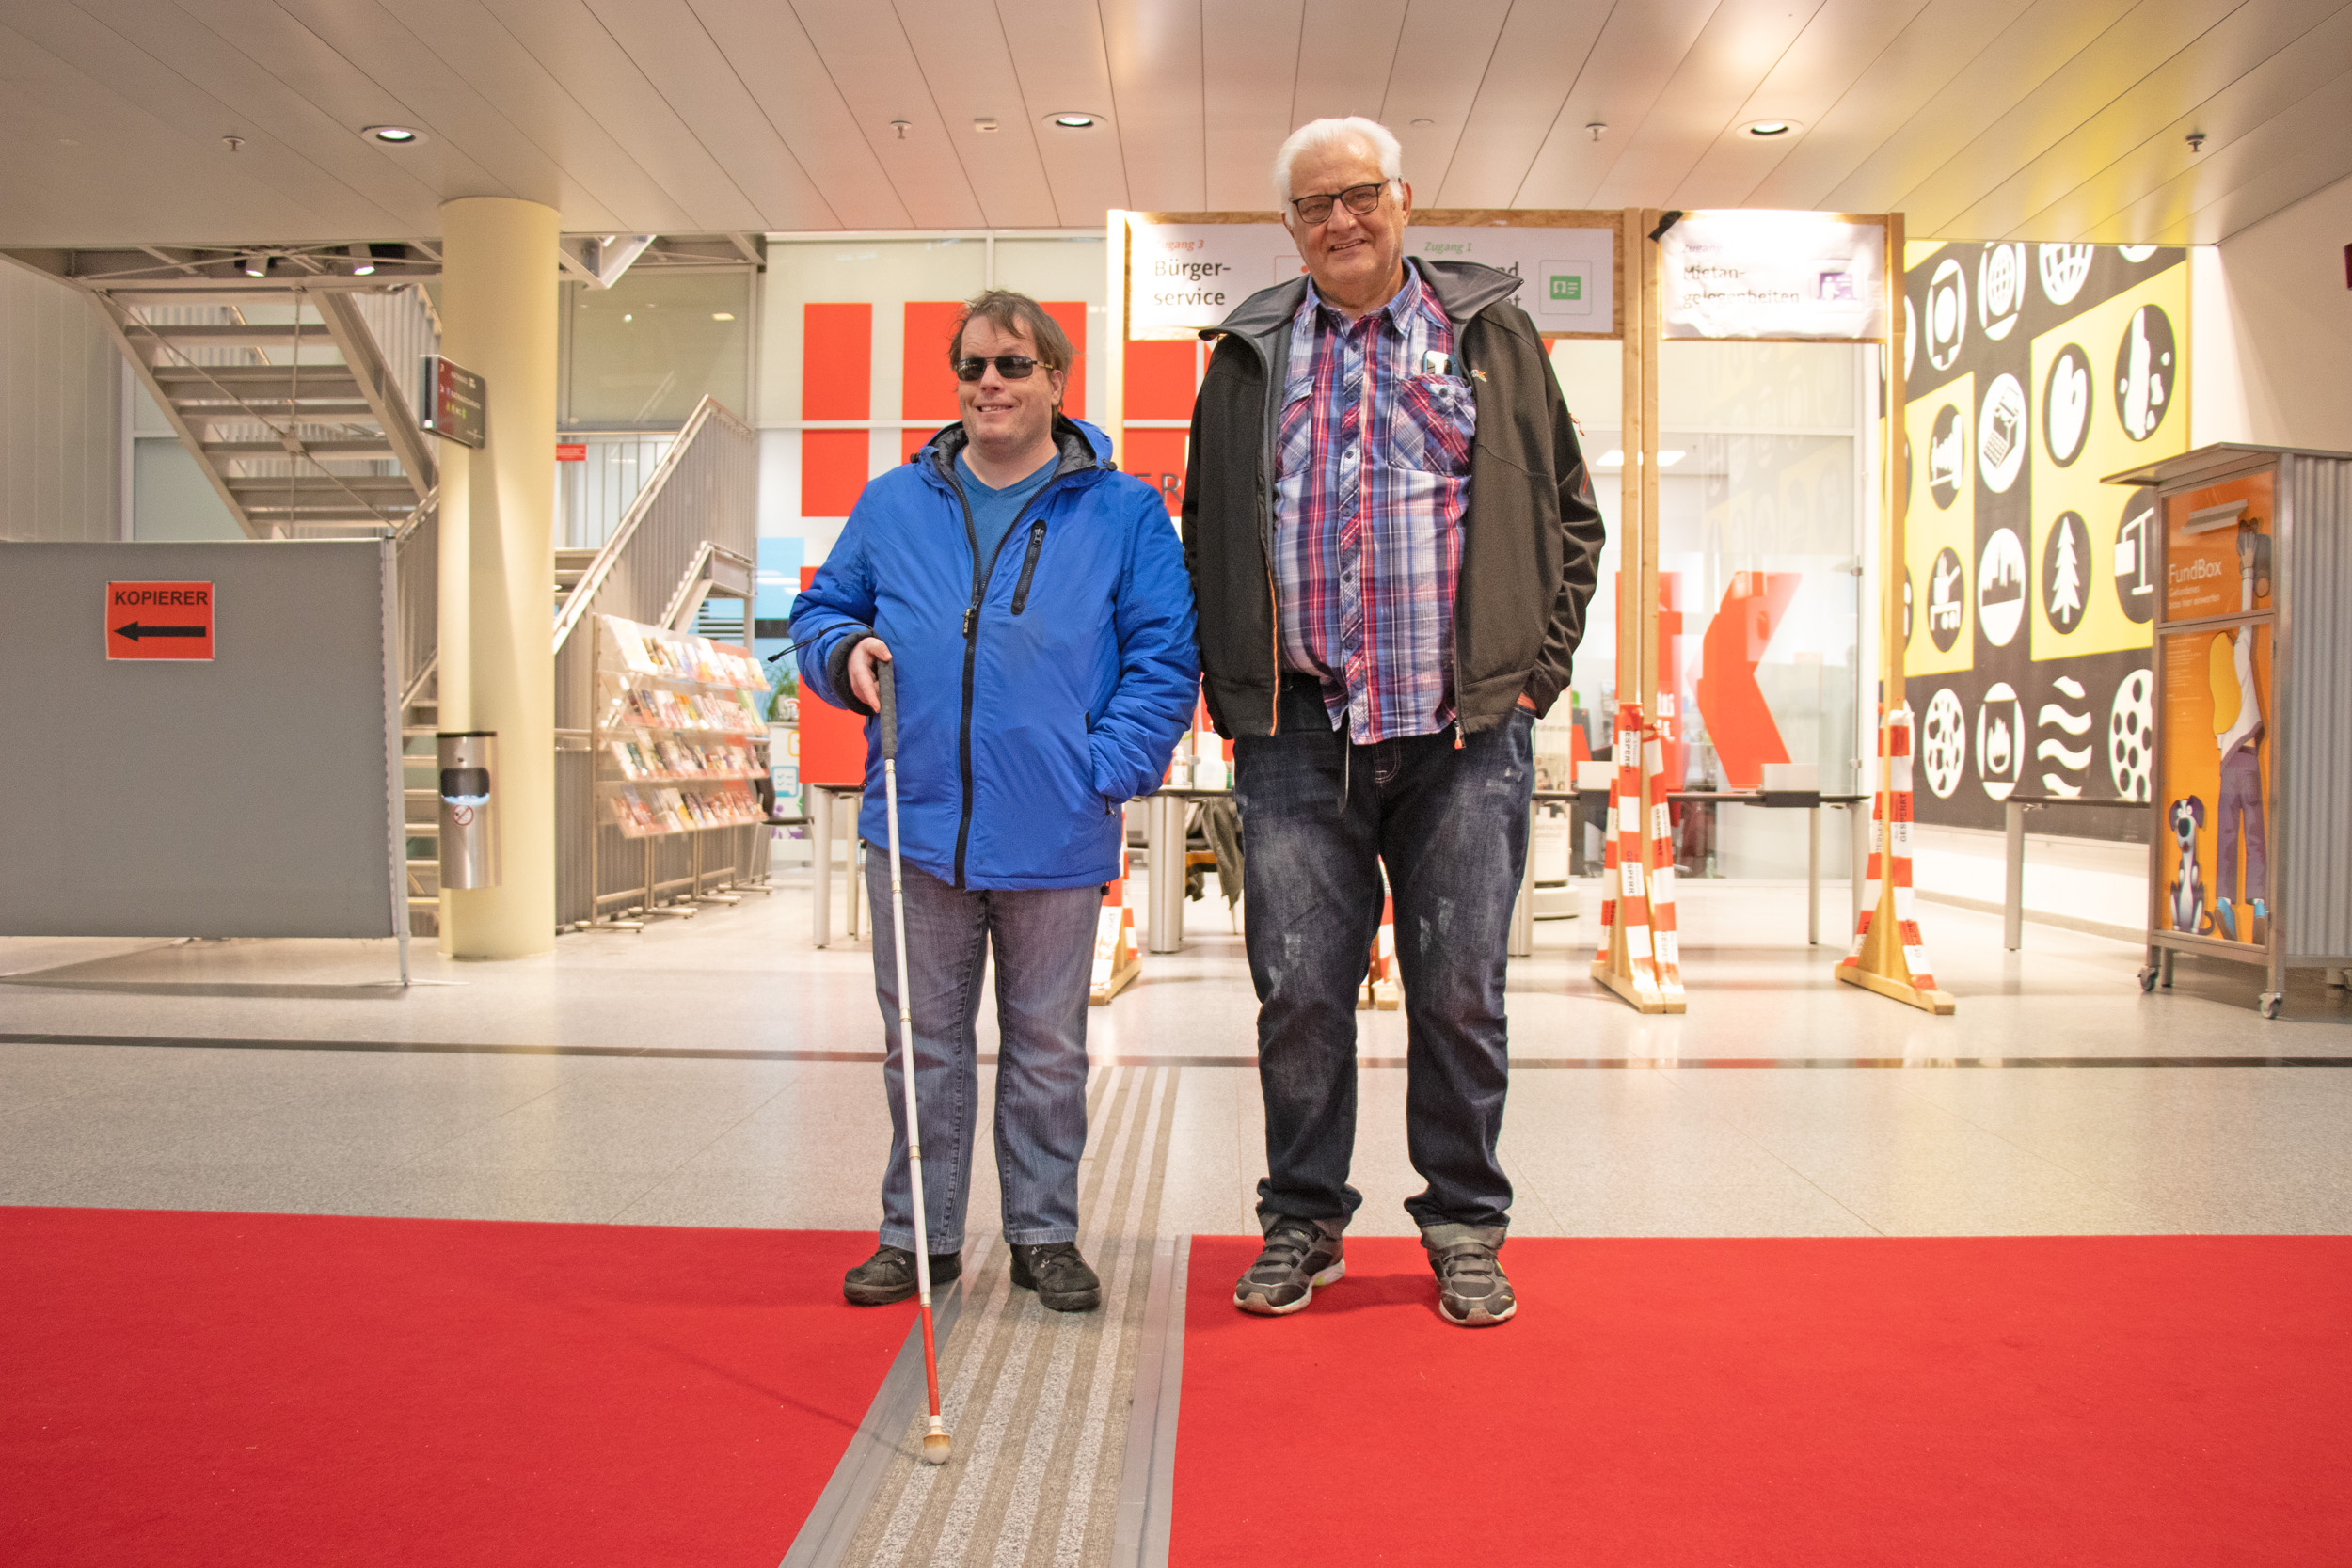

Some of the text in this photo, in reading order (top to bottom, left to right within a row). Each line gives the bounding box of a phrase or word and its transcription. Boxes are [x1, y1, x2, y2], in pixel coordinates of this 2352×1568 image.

[1155, 239, 1204, 252] ugang 3
[1424, 242, 1472, 254] Zugang 1
[1155, 258, 1231, 281] Bürger-
[1683, 264, 1746, 279] Mietan-
[1153, 286, 1226, 306] service
[2168, 558, 2223, 584] FundBox
[115, 591, 209, 606] KOPIERER
[1899, 792, 1908, 843] GESPERRT
